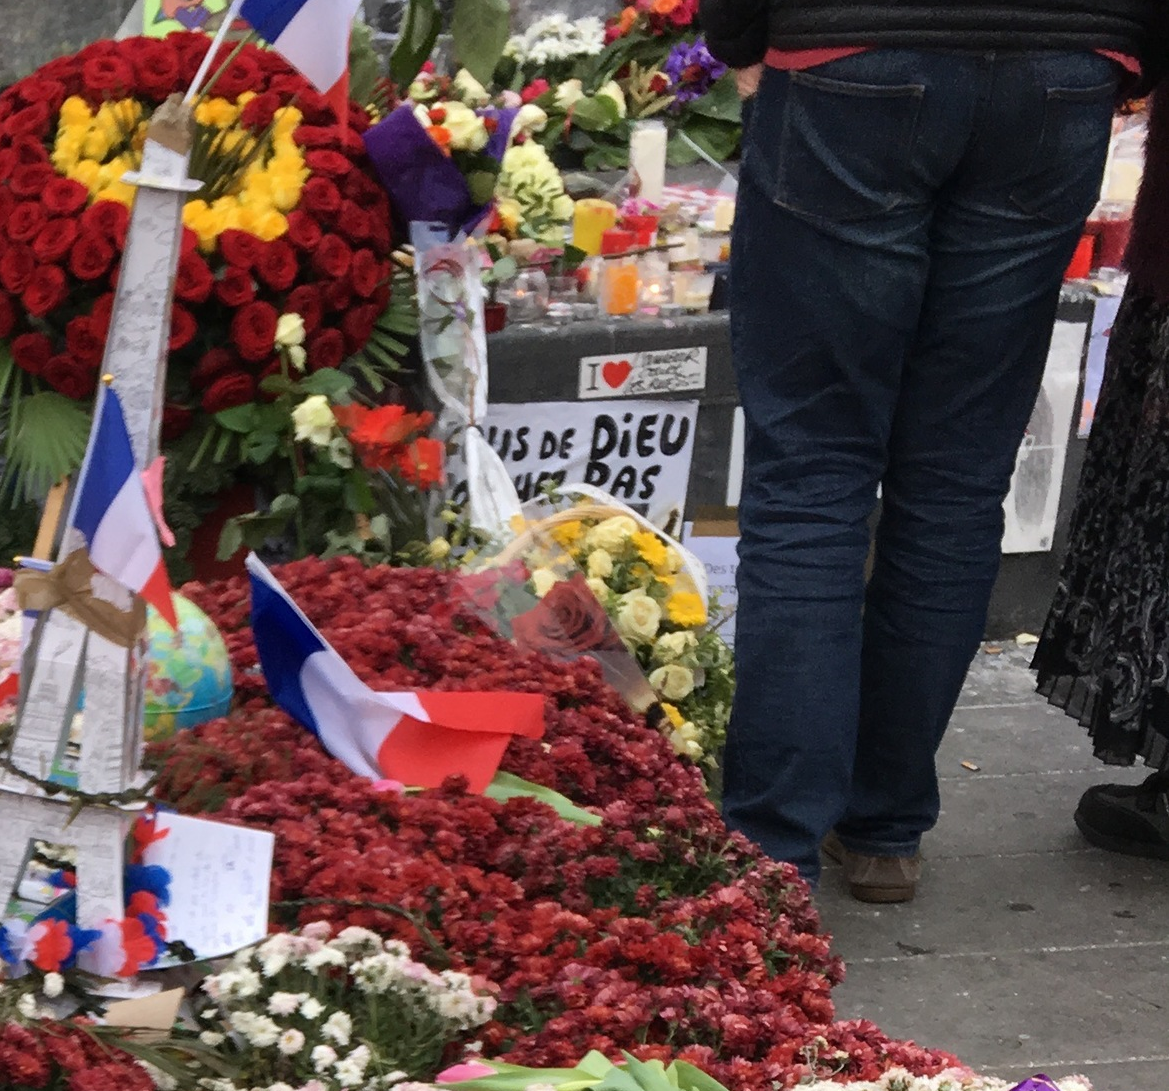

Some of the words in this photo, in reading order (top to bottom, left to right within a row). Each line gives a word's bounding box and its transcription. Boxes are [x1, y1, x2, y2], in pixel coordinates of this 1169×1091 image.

[586, 362, 600, 391] I
[539, 427, 577, 460] DE
[584, 460, 662, 500] PAS
